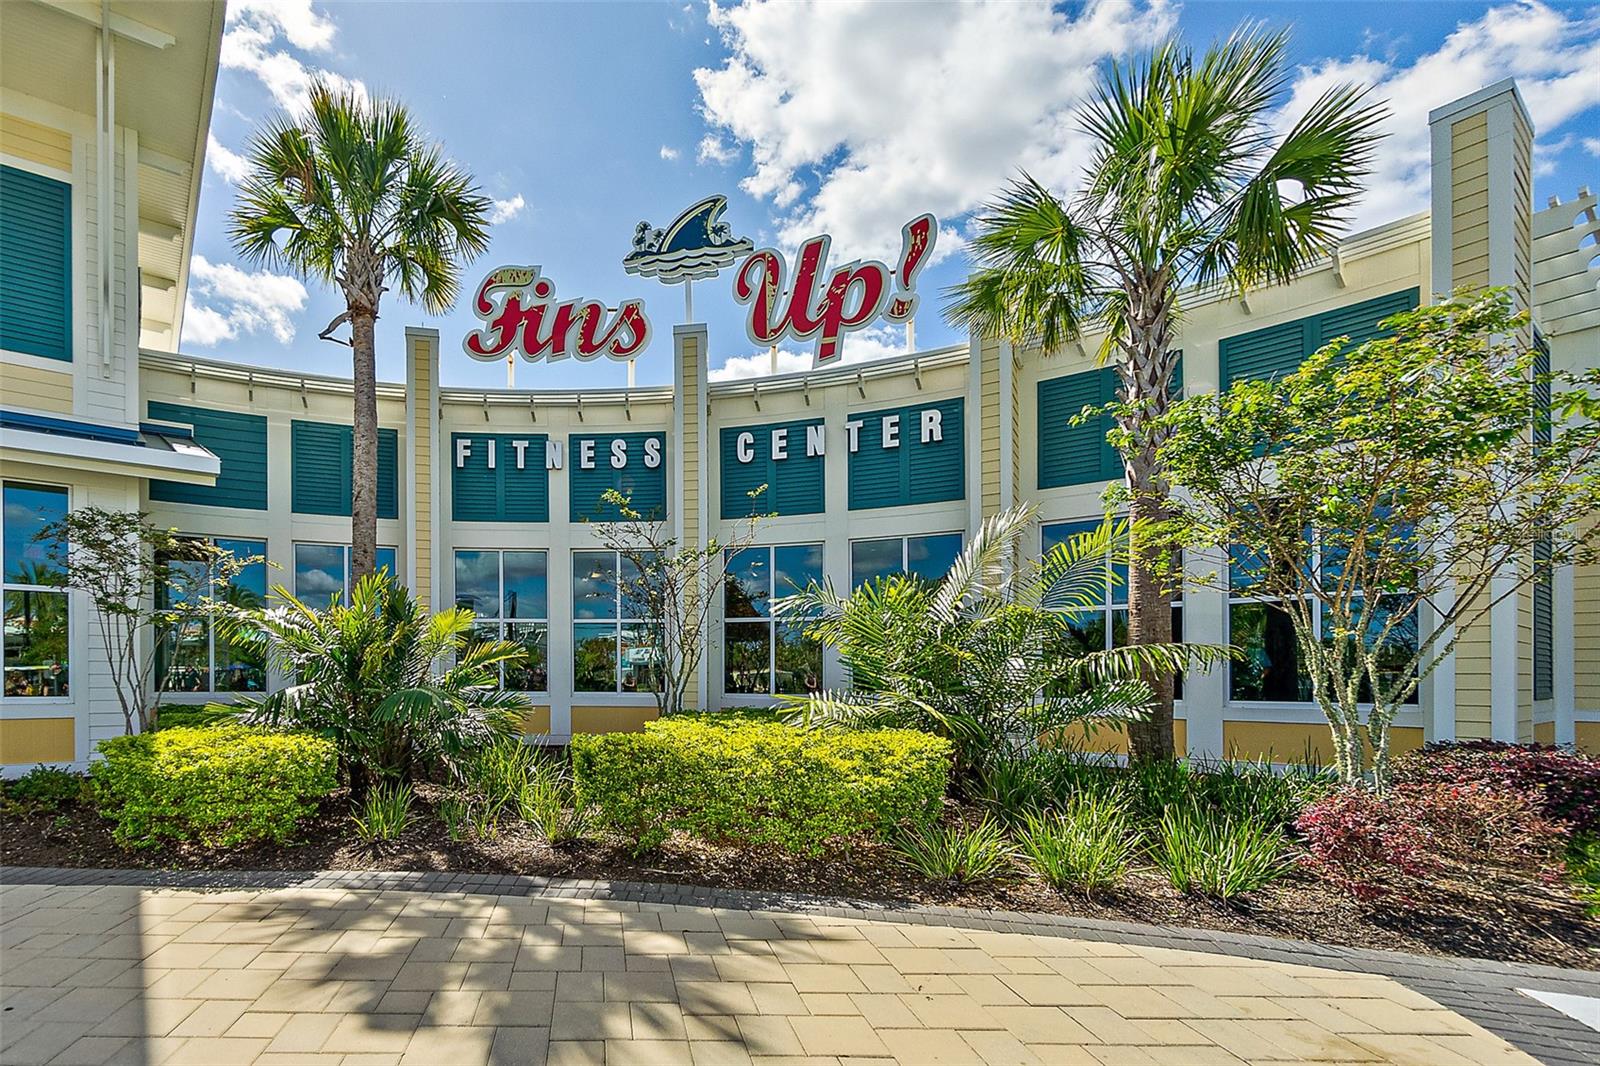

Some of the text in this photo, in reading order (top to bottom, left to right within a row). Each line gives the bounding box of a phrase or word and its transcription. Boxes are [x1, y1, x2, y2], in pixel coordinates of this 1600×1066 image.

[464, 214, 936, 368] Fins Up!
[456, 409, 943, 469] FITNESS CENTER
